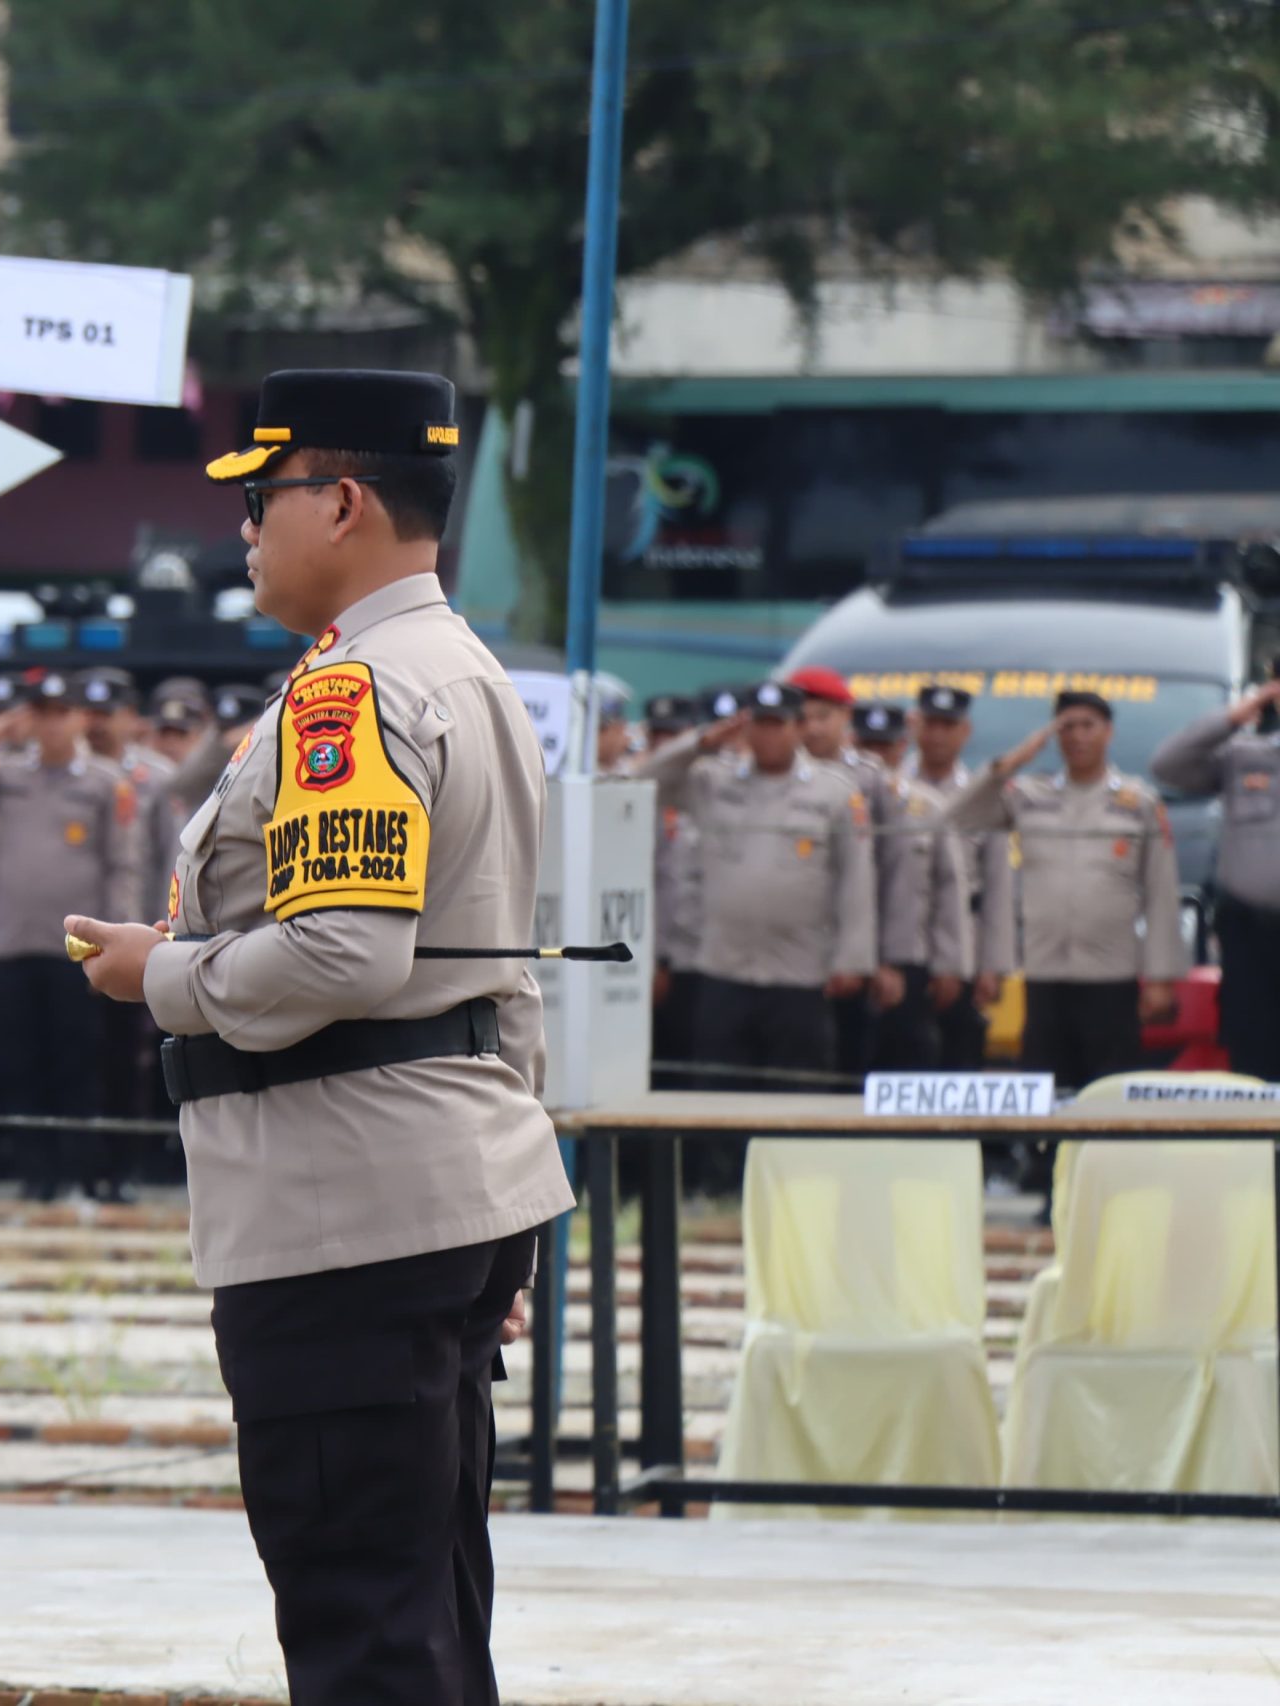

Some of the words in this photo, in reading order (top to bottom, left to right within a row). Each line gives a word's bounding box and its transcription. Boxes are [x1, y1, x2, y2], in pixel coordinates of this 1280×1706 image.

[23, 317, 73, 341] TPS
[82, 322, 116, 346] 01
[269, 814, 310, 874] KAOPS
[318, 808, 409, 856] RESTABES
[301, 855, 407, 883] TOBA-2024
[601, 889, 646, 942] KPU
[876, 1081, 1040, 1115] PENCATAT
